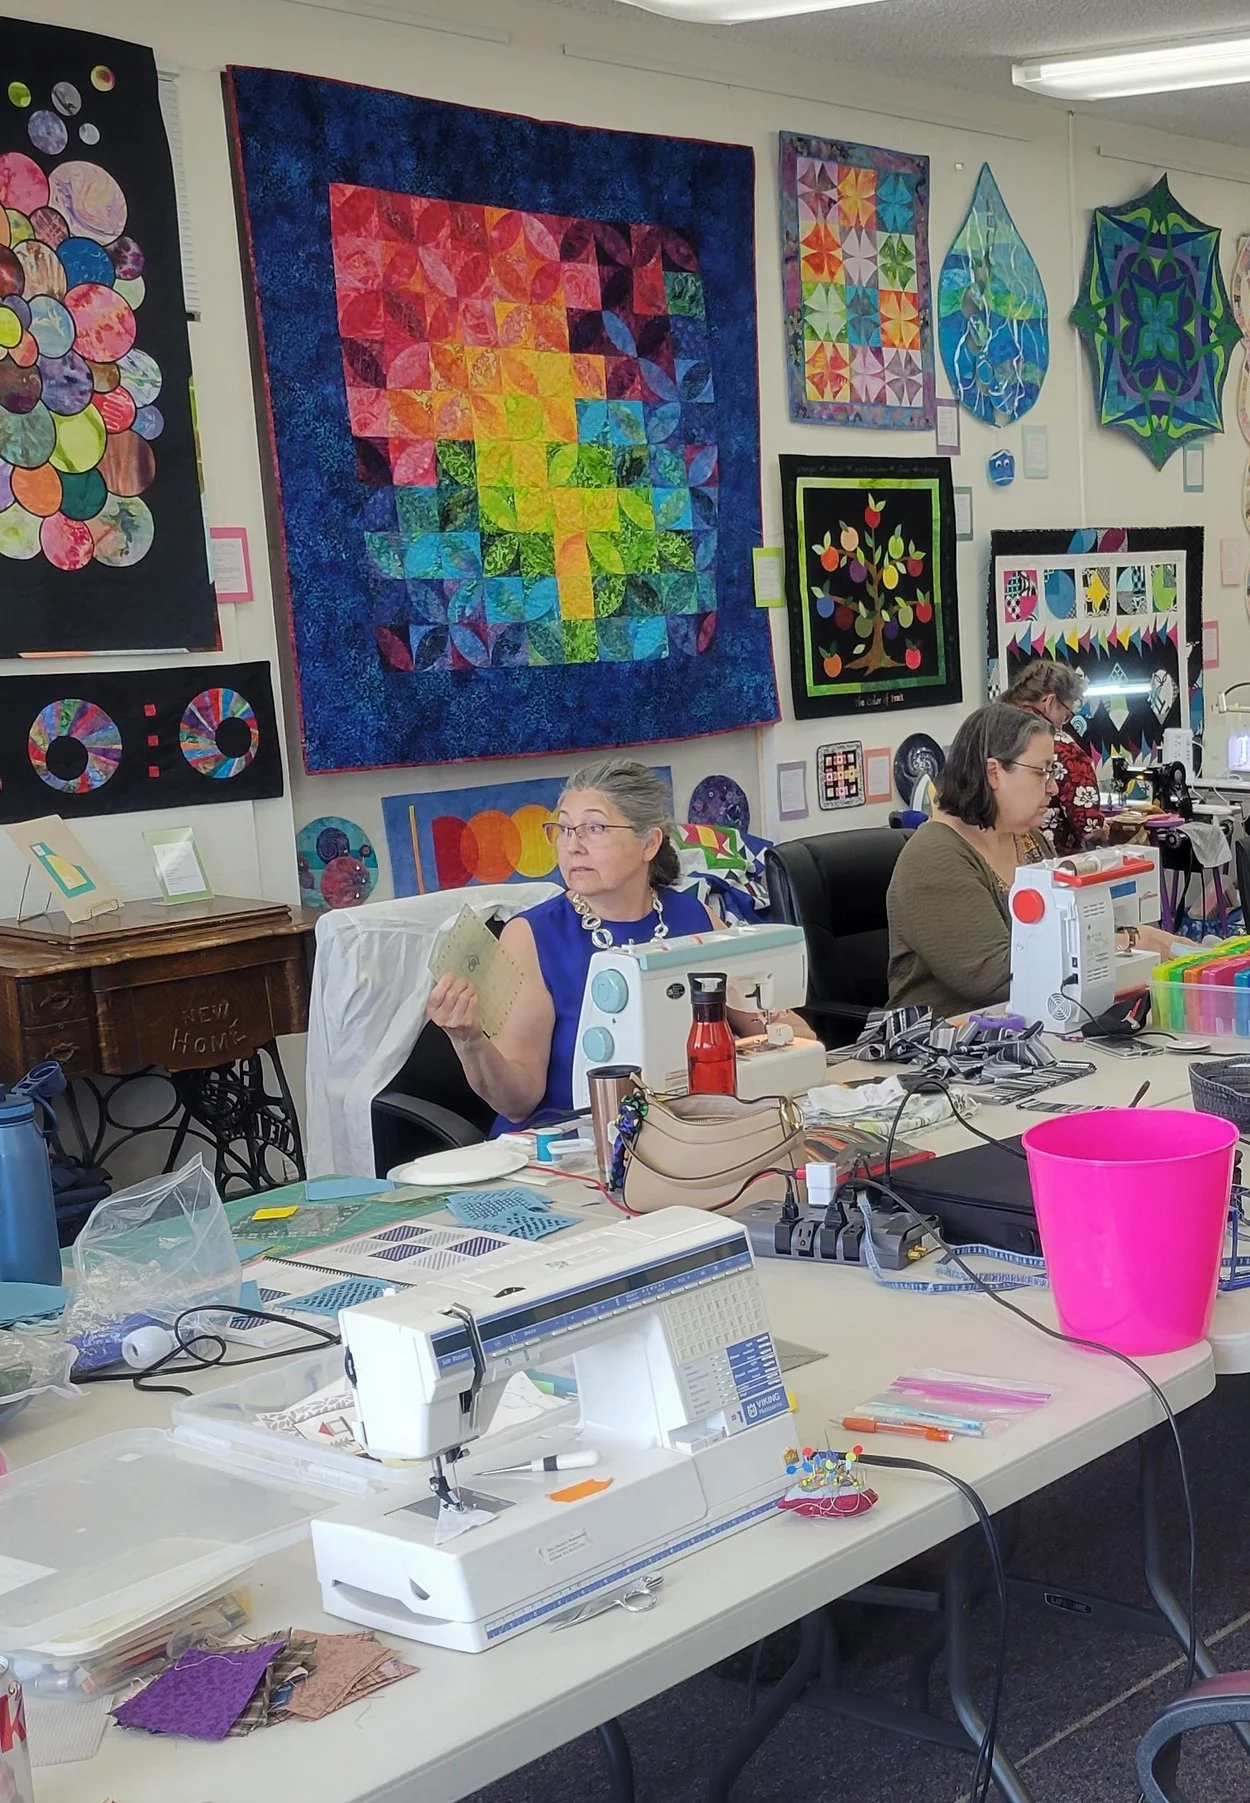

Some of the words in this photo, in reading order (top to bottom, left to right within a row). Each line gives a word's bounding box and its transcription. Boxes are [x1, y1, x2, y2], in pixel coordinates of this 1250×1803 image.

[183, 1002, 230, 1025] NEW
[171, 1018, 247, 1054] HOME
[755, 1392, 781, 1408] VIKING
